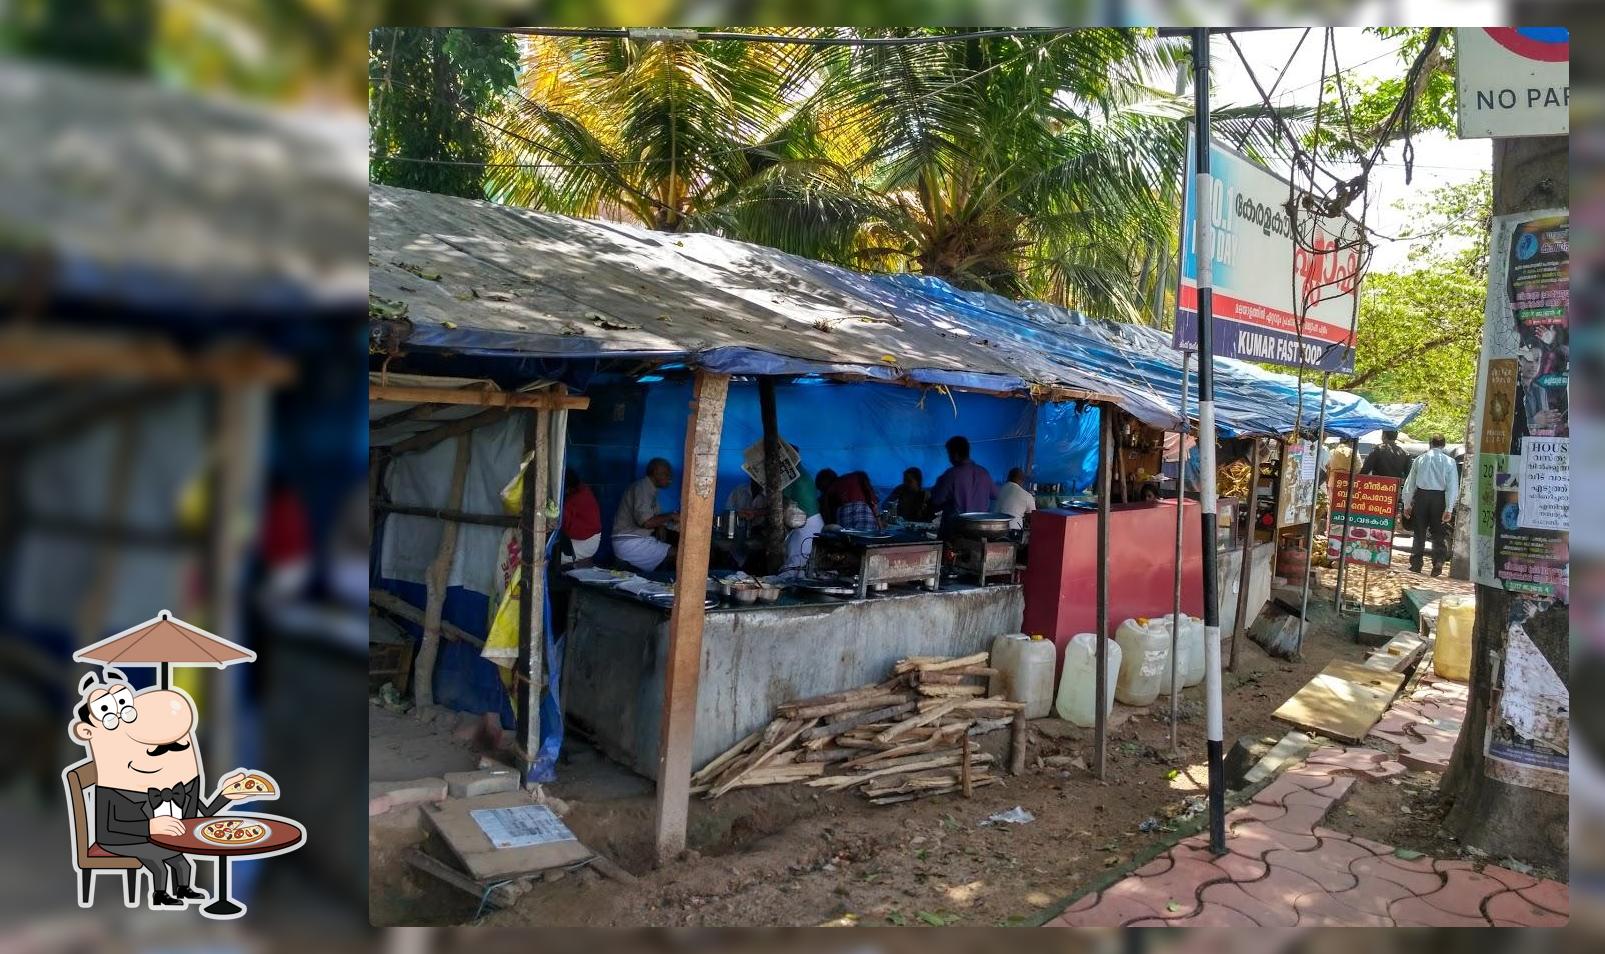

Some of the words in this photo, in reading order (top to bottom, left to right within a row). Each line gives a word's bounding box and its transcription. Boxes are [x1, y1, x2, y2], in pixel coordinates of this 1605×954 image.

[1476, 88, 1517, 110] NO
[1237, 330, 1275, 359] KUMAR
[1276, 338, 1300, 363] FAST
